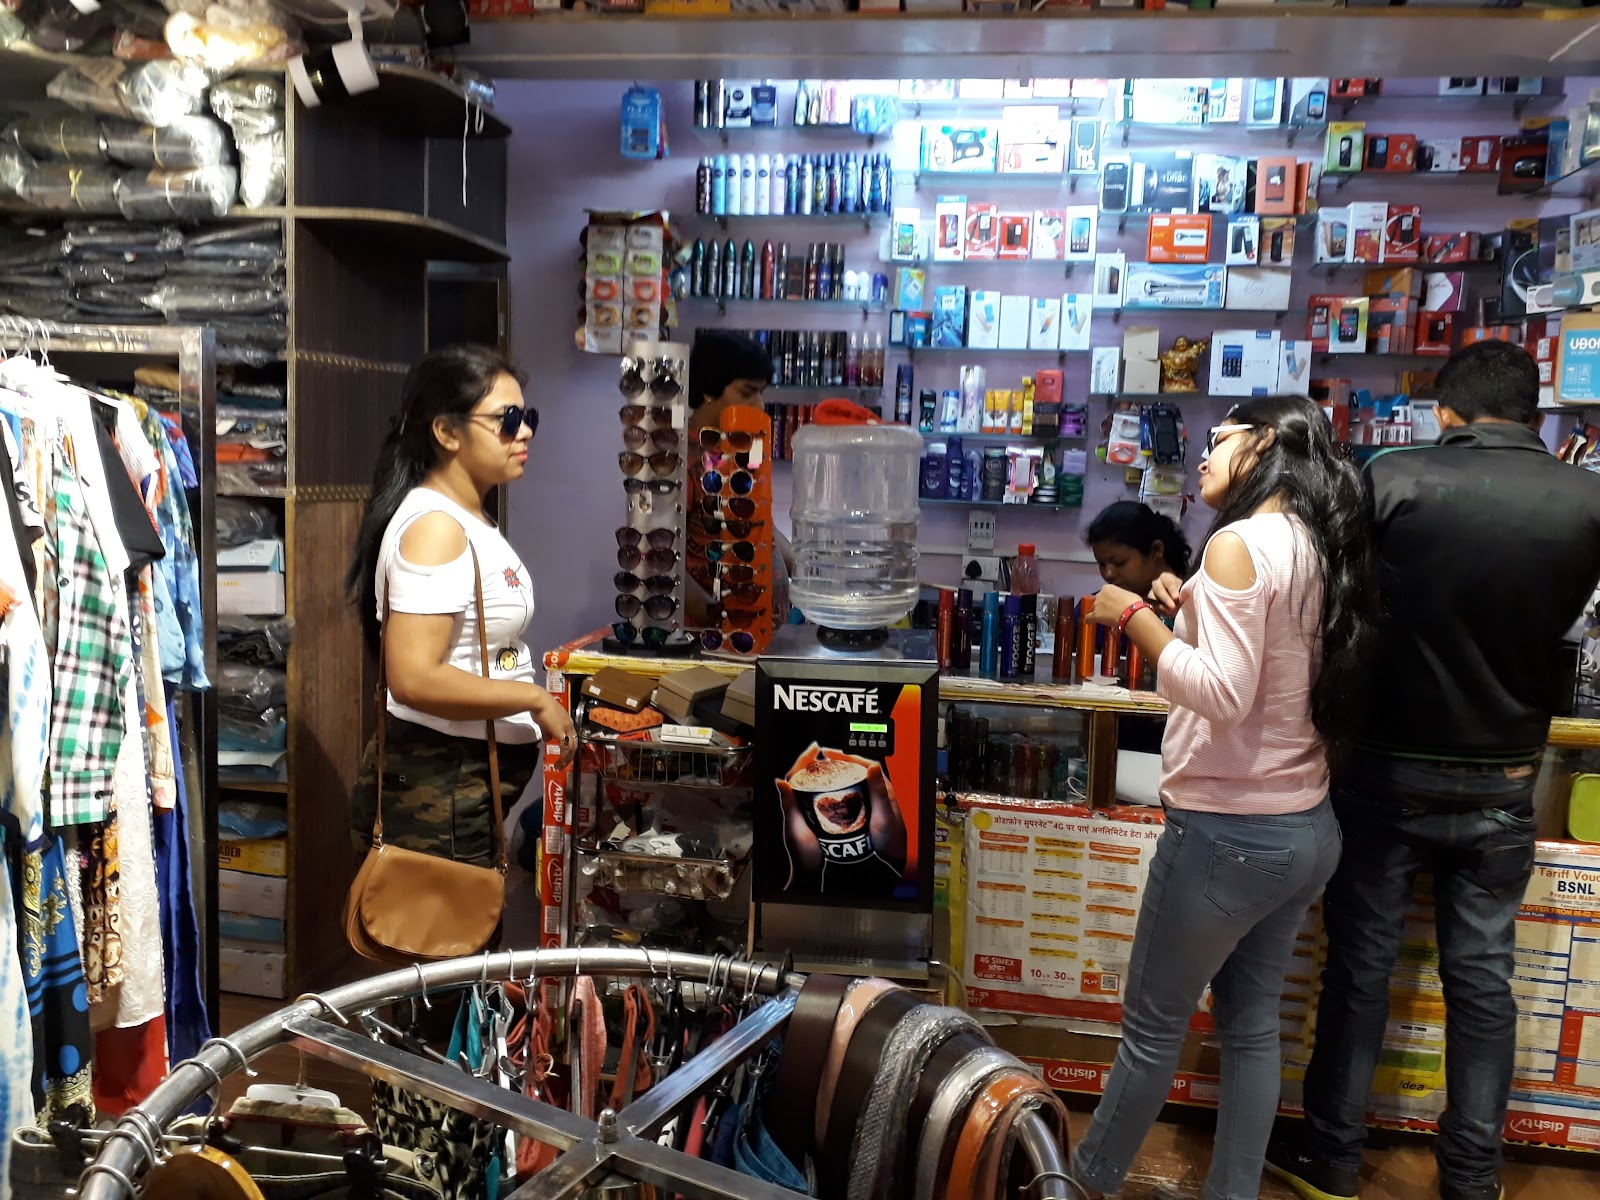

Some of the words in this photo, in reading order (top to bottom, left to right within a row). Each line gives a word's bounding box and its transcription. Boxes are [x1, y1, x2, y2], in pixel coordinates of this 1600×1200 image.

[1569, 337, 1600, 350] UBO
[1026, 631, 1035, 665] FOGG
[773, 684, 879, 714] NESCAFÉ
[552, 783, 564, 823] dishtv
[1053, 822, 1064, 830] 4G
[1066, 824, 1075, 832] पर
[1129, 828, 1142, 839] डेटा
[1144, 830, 1158, 840] और
[219, 846, 241, 858] ADER
[1539, 867, 1570, 879] Tariff
[553, 866, 563, 903] dishtv
[1557, 880, 1596, 895] BSNL
[1551, 908, 1573, 916] FROM
[979, 956, 990, 964] 4G
[991, 957, 1015, 967] SIMEX
[1030, 969, 1042, 978] 10
[1054, 971, 1067, 980] 30
[1055, 1065, 1097, 1080] dishtv
[1520, 1118, 1566, 1133] dishtv
